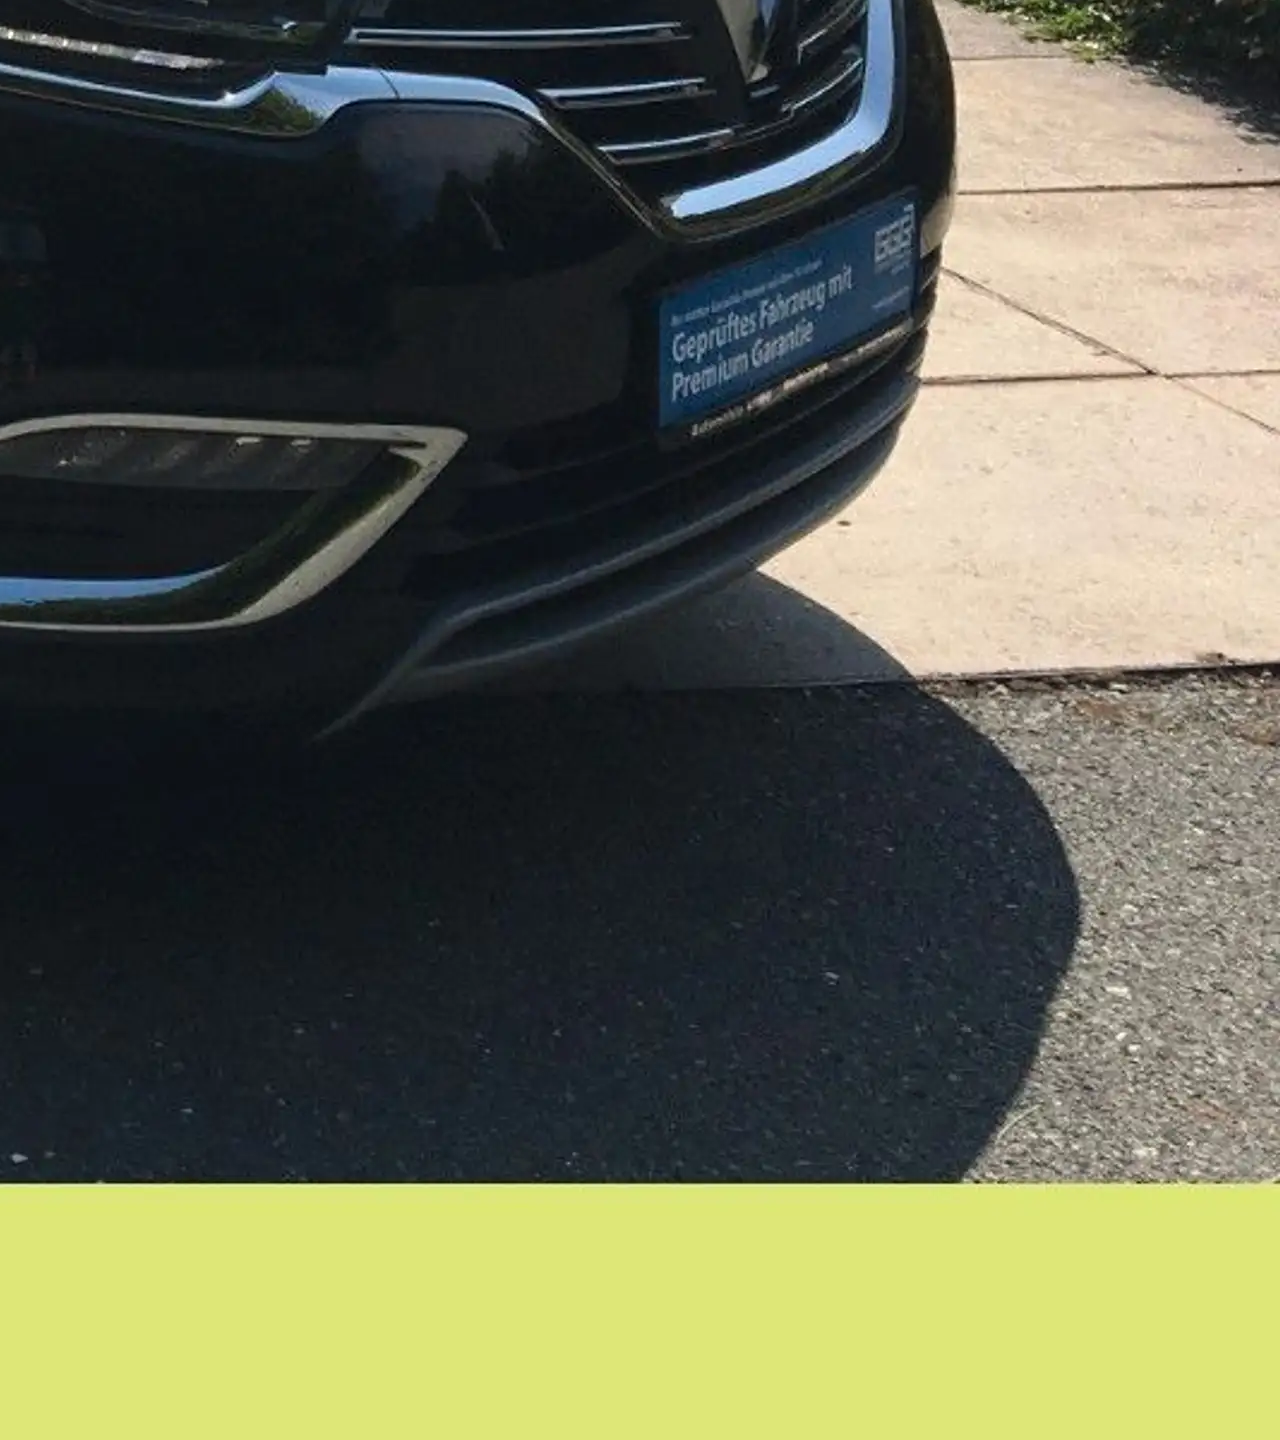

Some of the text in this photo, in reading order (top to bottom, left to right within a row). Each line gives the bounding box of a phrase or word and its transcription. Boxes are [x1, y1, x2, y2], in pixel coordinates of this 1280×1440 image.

[671, 309, 757, 365] Geprüftes
[758, 279, 827, 330] Fahrzeug
[828, 263, 853, 296] mit
[671, 351, 749, 403] Premium
[751, 318, 815, 368] Garantie
